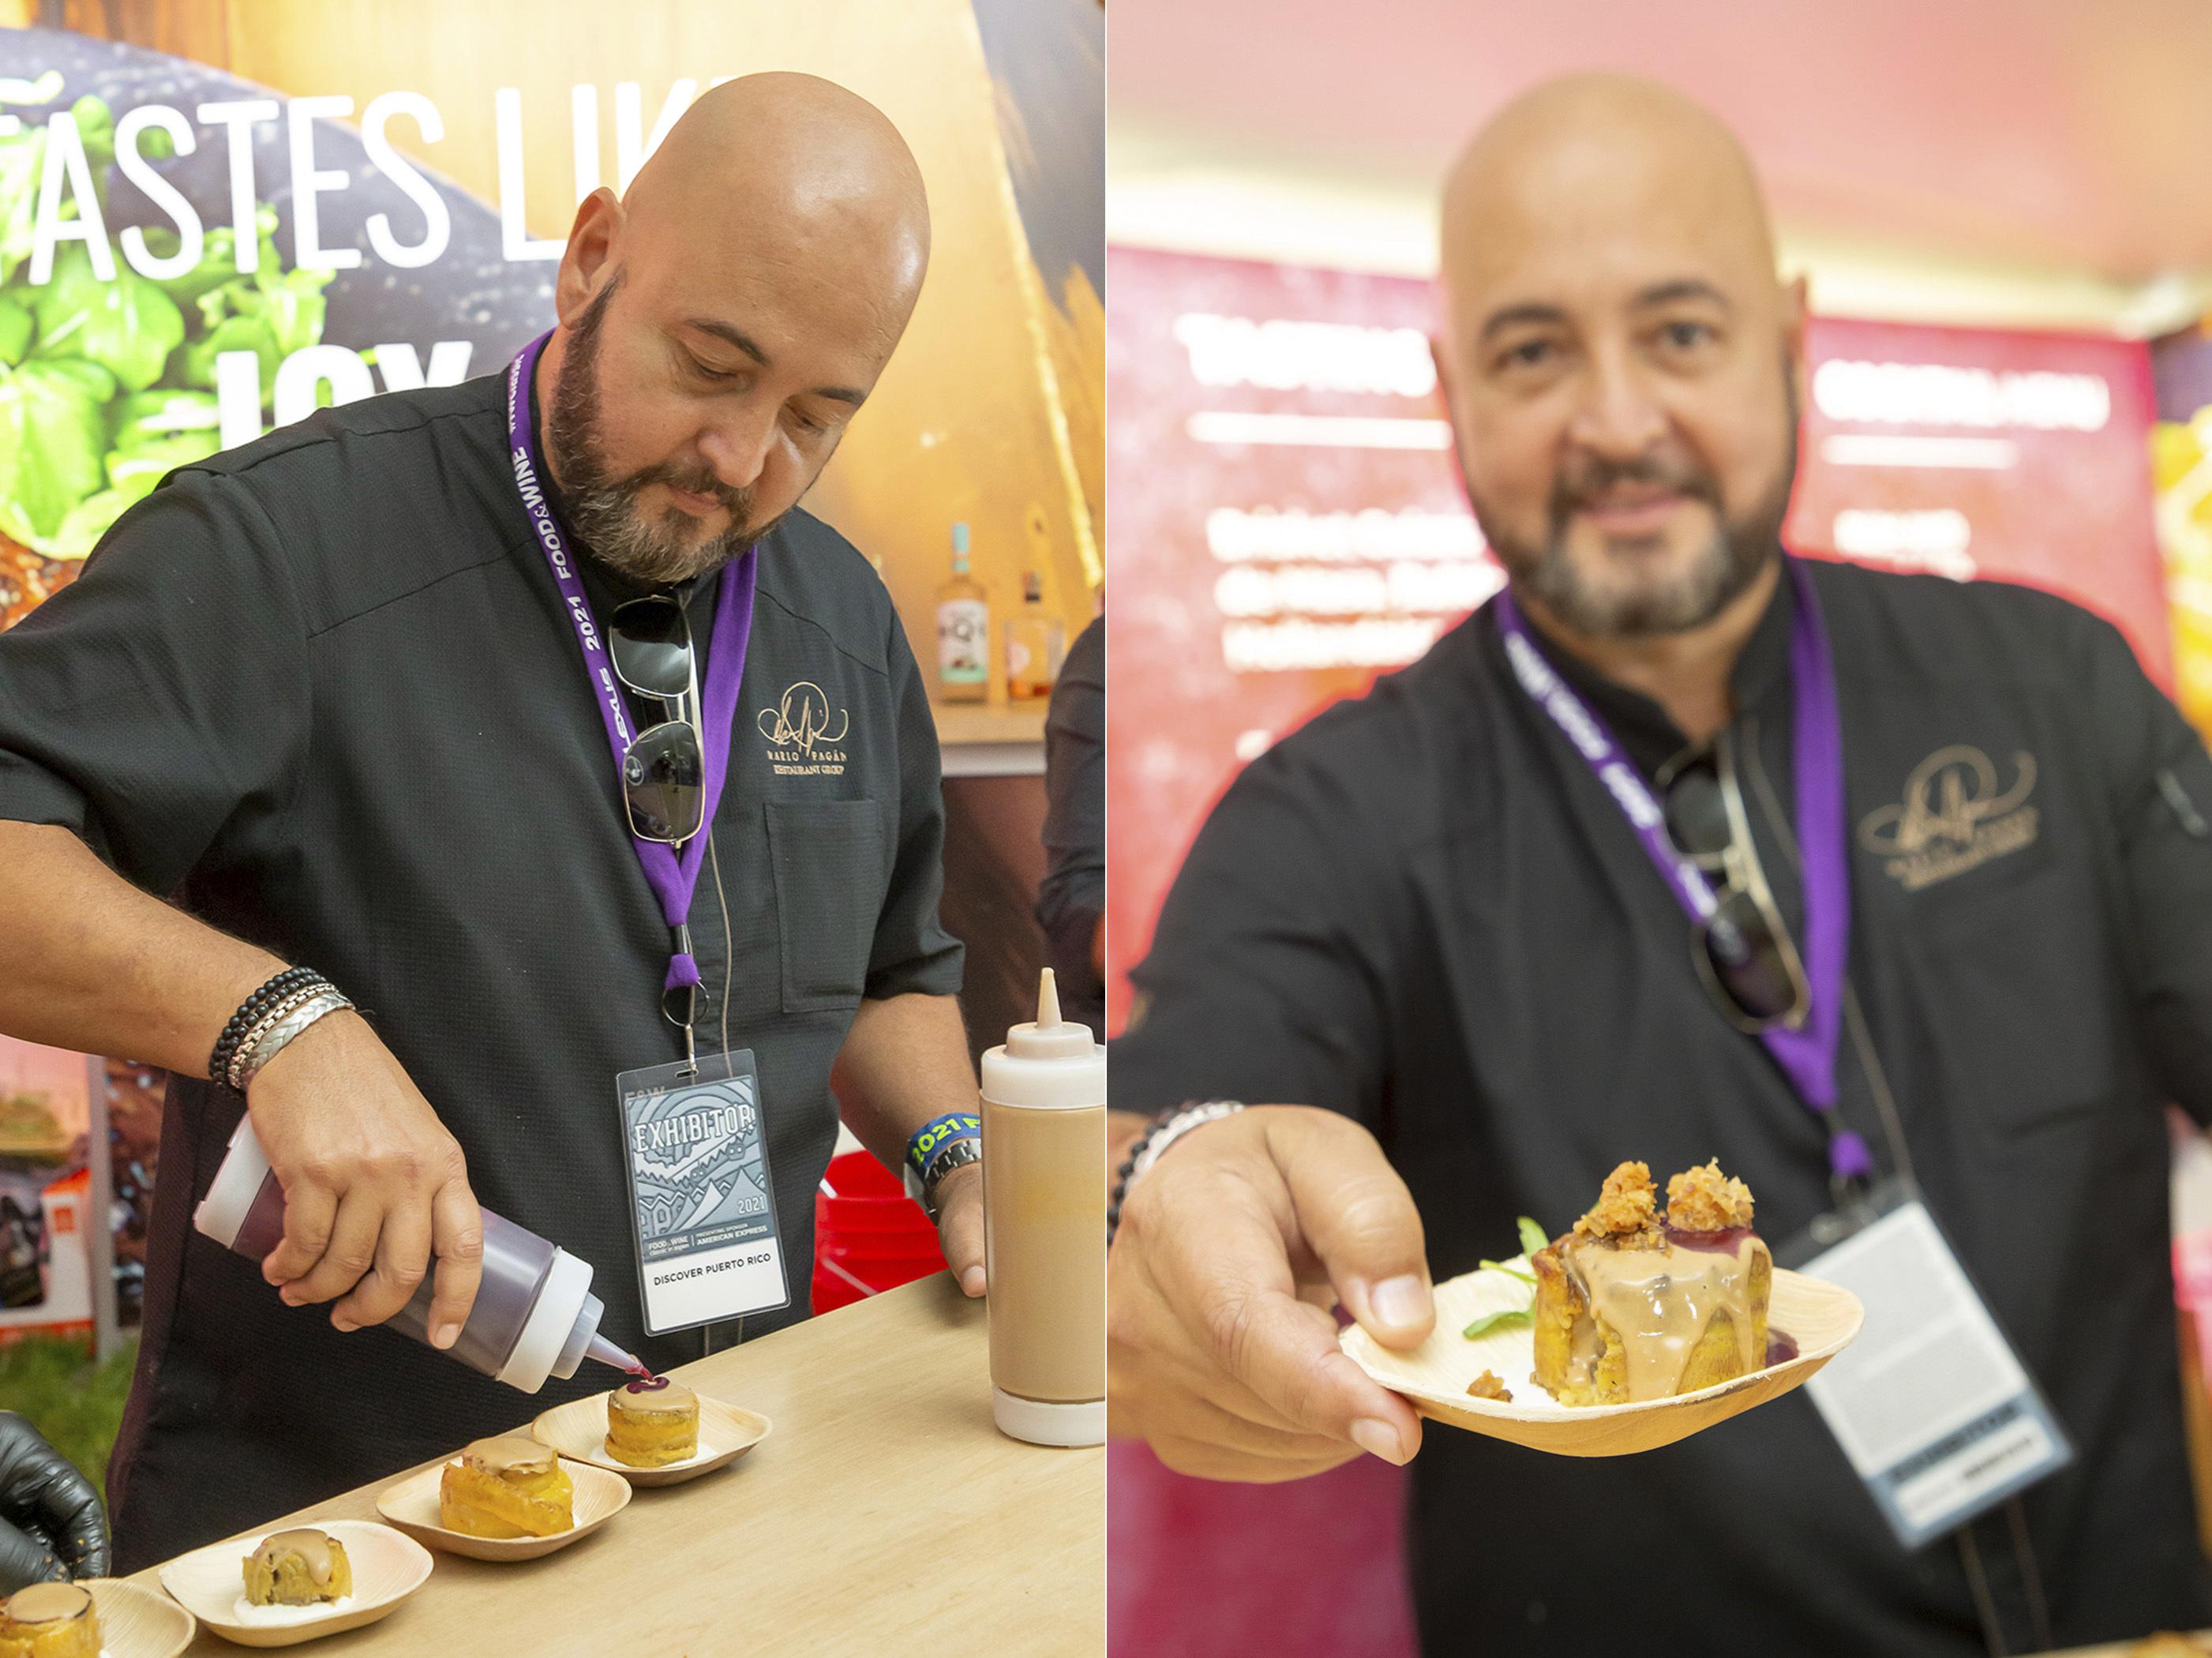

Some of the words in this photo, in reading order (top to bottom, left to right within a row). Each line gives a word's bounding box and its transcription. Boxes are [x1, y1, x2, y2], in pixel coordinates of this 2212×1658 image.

[0, 91, 451, 285] ASTES
[495, 75, 739, 261] LIK
[514, 447, 544, 509] WINE
[538, 520, 572, 580] FOOD
[568, 596, 601, 651] 2021
[634, 1104, 752, 1153] EXHIBITOR
[912, 1118, 962, 1165] 2021
[737, 1195, 766, 1215] 2021
[696, 1232, 734, 1246] AMERICAN
[735, 1225, 768, 1239] EXPRESS
[654, 1267, 703, 1286] DISCOVER
[706, 1259, 745, 1274] PUERTO
[748, 1253, 771, 1266] RICO
